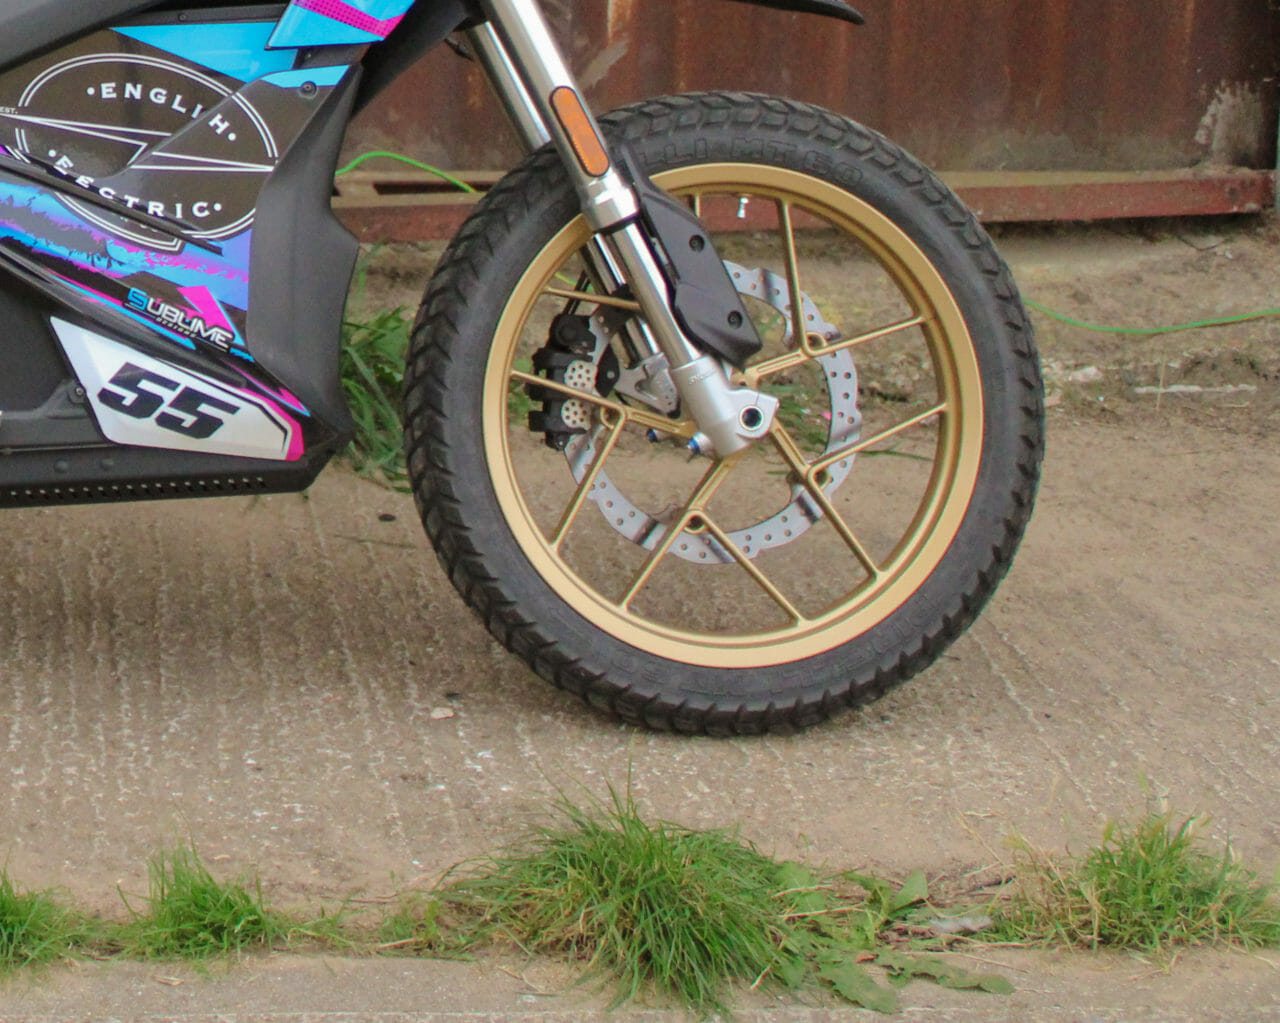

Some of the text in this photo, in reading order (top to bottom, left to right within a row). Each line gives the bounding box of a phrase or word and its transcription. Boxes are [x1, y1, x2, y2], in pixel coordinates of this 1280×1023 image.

[100, 82, 230, 135] ENGLIH
[53, 155, 210, 218] EECTRIC
[127, 287, 233, 349] SUBLIME
[97, 362, 241, 439] 55
